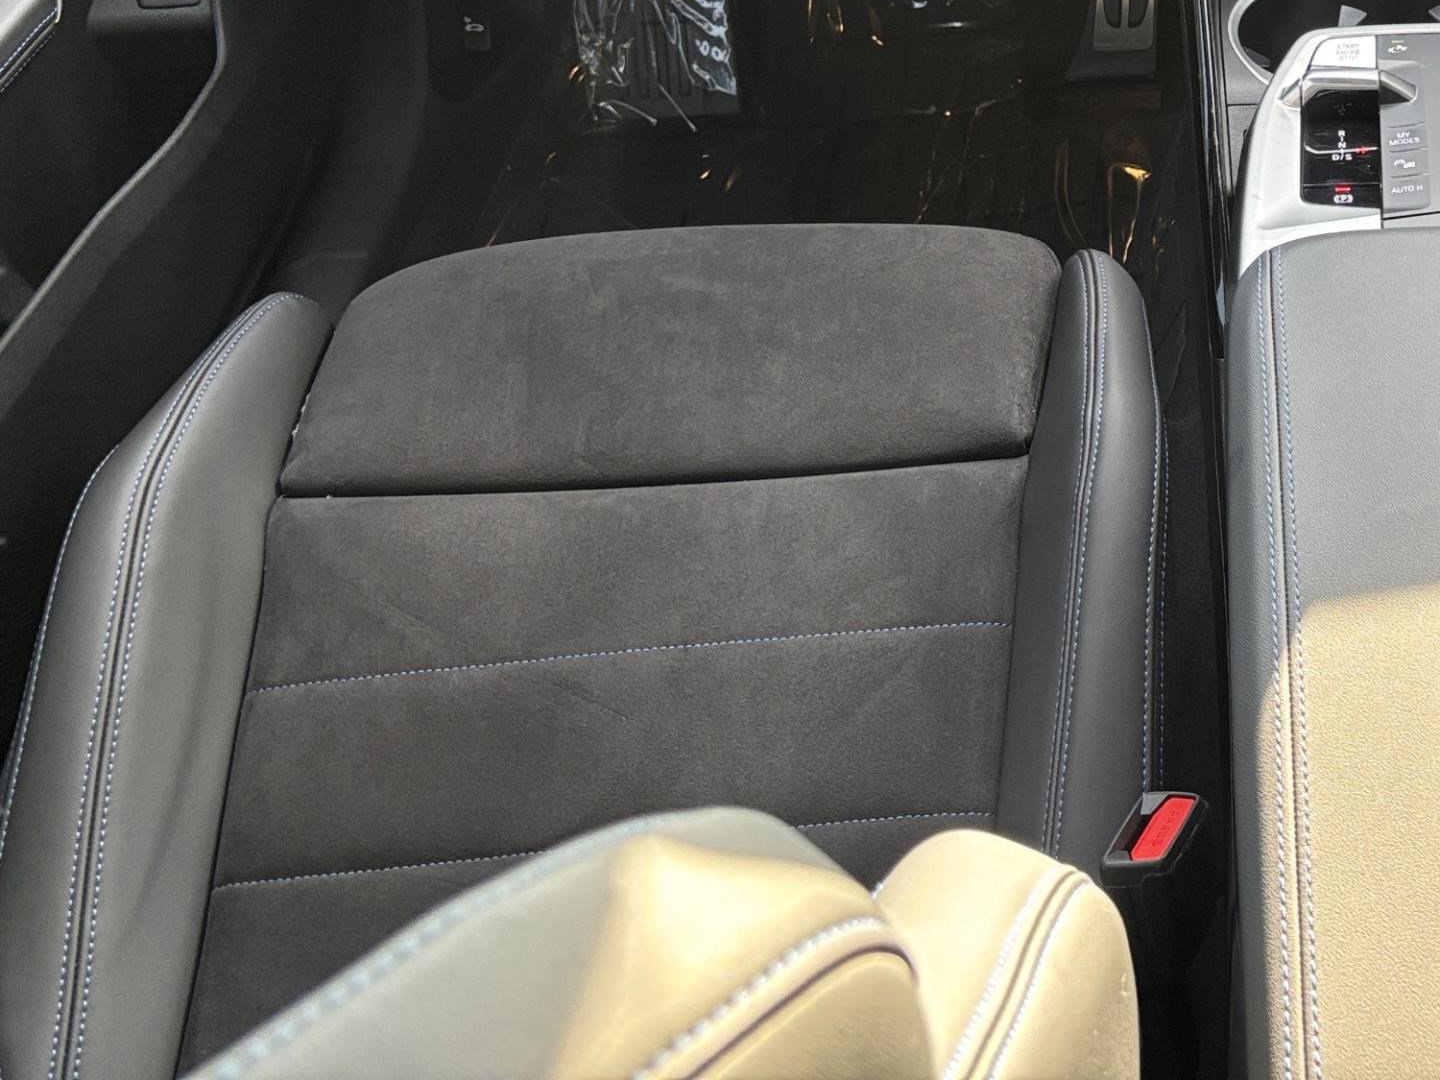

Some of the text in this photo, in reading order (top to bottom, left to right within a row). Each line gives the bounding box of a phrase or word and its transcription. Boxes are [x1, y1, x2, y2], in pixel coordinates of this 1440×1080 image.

[1337, 129, 1346, 137] R
[1396, 131, 1410, 139] MY
[1337, 141, 1347, 149] N
[1388, 137, 1420, 147] MODES
[1391, 184, 1424, 195] AUTO H
